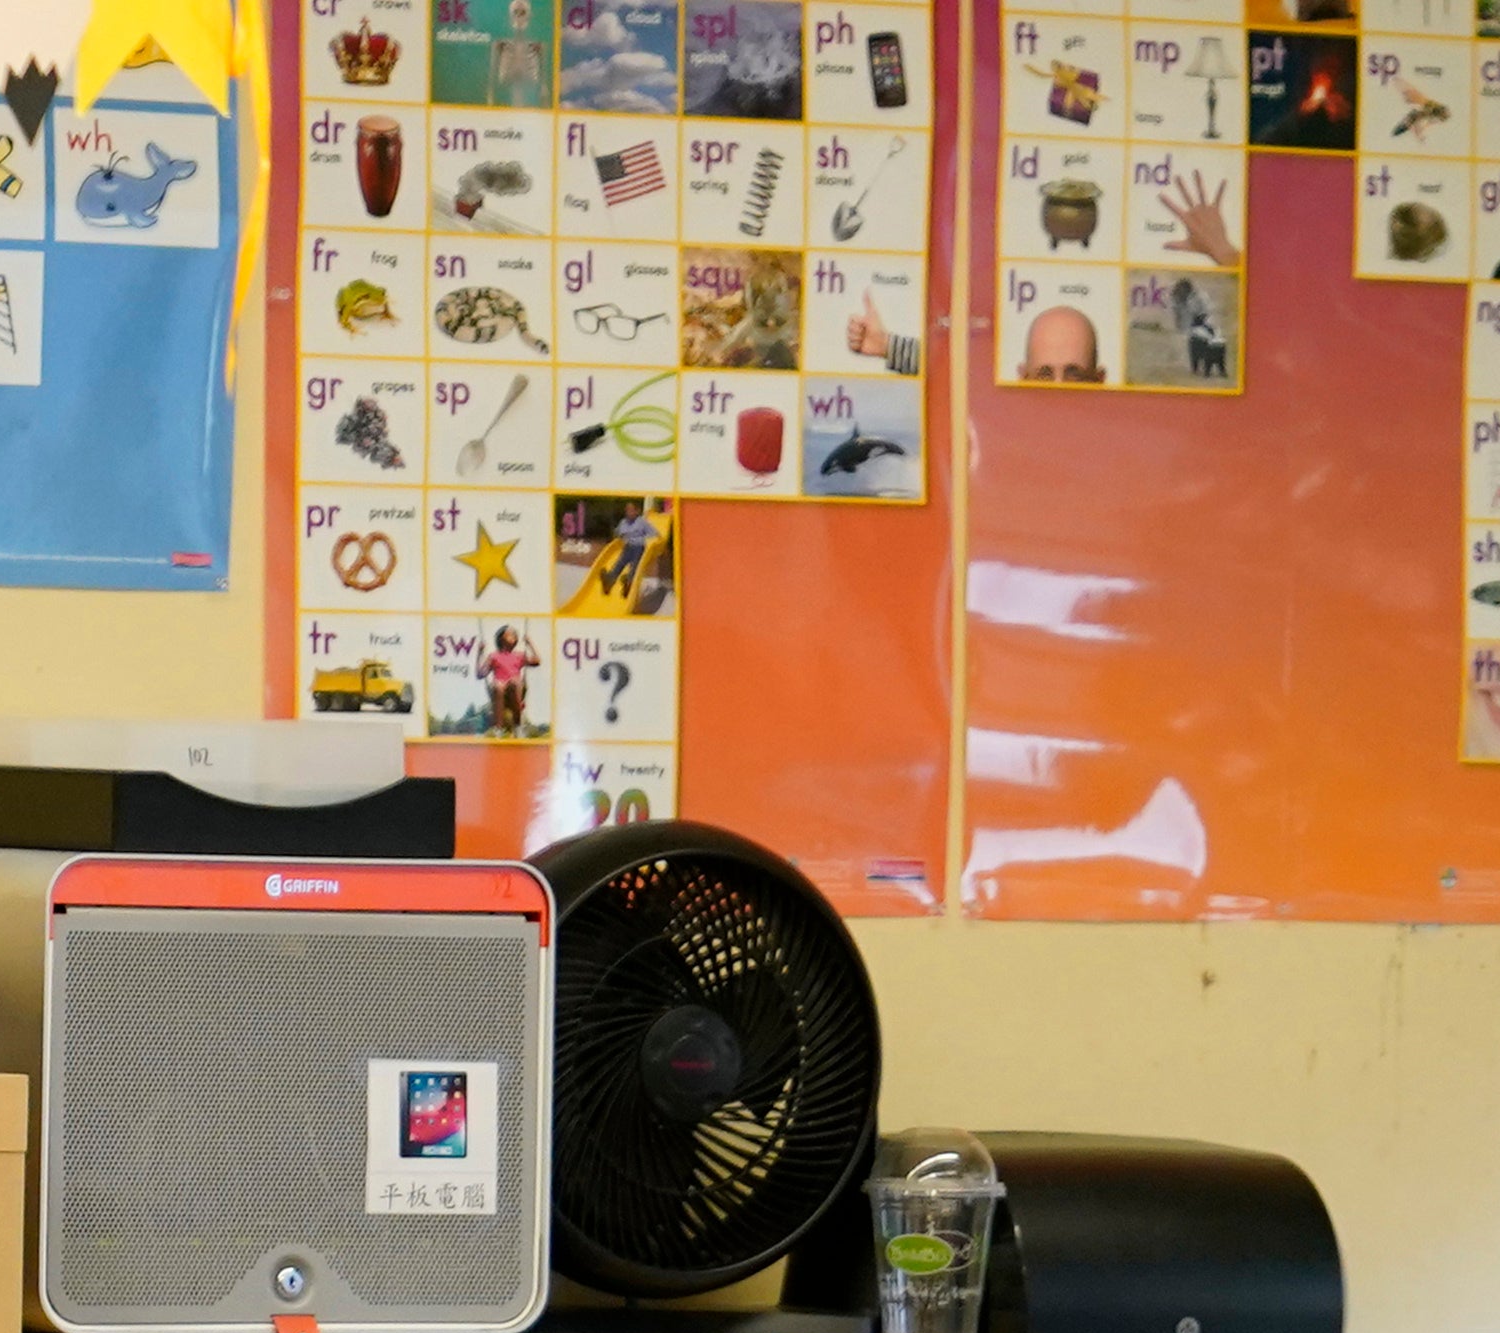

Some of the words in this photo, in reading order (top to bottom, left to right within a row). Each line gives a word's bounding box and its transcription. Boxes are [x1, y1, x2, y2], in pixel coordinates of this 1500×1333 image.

[568, 0, 593, 30] cl
[693, 6, 736, 46] spl
[816, 11, 854, 54] ph
[1135, 40, 1180, 73] mp
[1368, 54, 1400, 85] sp
[67, 119, 116, 156] wh
[311, 110, 345, 144] dr
[438, 128, 477, 151] sm
[567, 123, 585, 156] fl
[691, 140, 739, 174] spr
[817, 136, 848, 168] sh
[1012, 145, 1039, 179] ld
[1135, 154, 1172, 186] nd
[1366, 166, 1391, 197] st
[313, 238, 338, 272] fr
[371, 251, 397, 268] frog
[435, 255, 465, 278] sn
[564, 250, 592, 289] gl
[687, 261, 742, 290] squ
[814, 261, 844, 293] th
[1010, 270, 1036, 309] lp
[307, 378, 342, 410] gr
[436, 382, 470, 409] sp
[566, 376, 593, 415] pl
[692, 381, 734, 413] str
[809, 387, 853, 418] wh
[307, 505, 343, 540] pr
[433, 498, 460, 531] st
[309, 621, 337, 654] tr
[369, 633, 401, 645] truck
[434, 632, 476, 657] sw
[563, 638, 599, 670] qu
[565, 754, 604, 783] tw
[280, 876, 339, 896] GRIFFIN
[380, 1183, 484, 1209] 平板電腦
